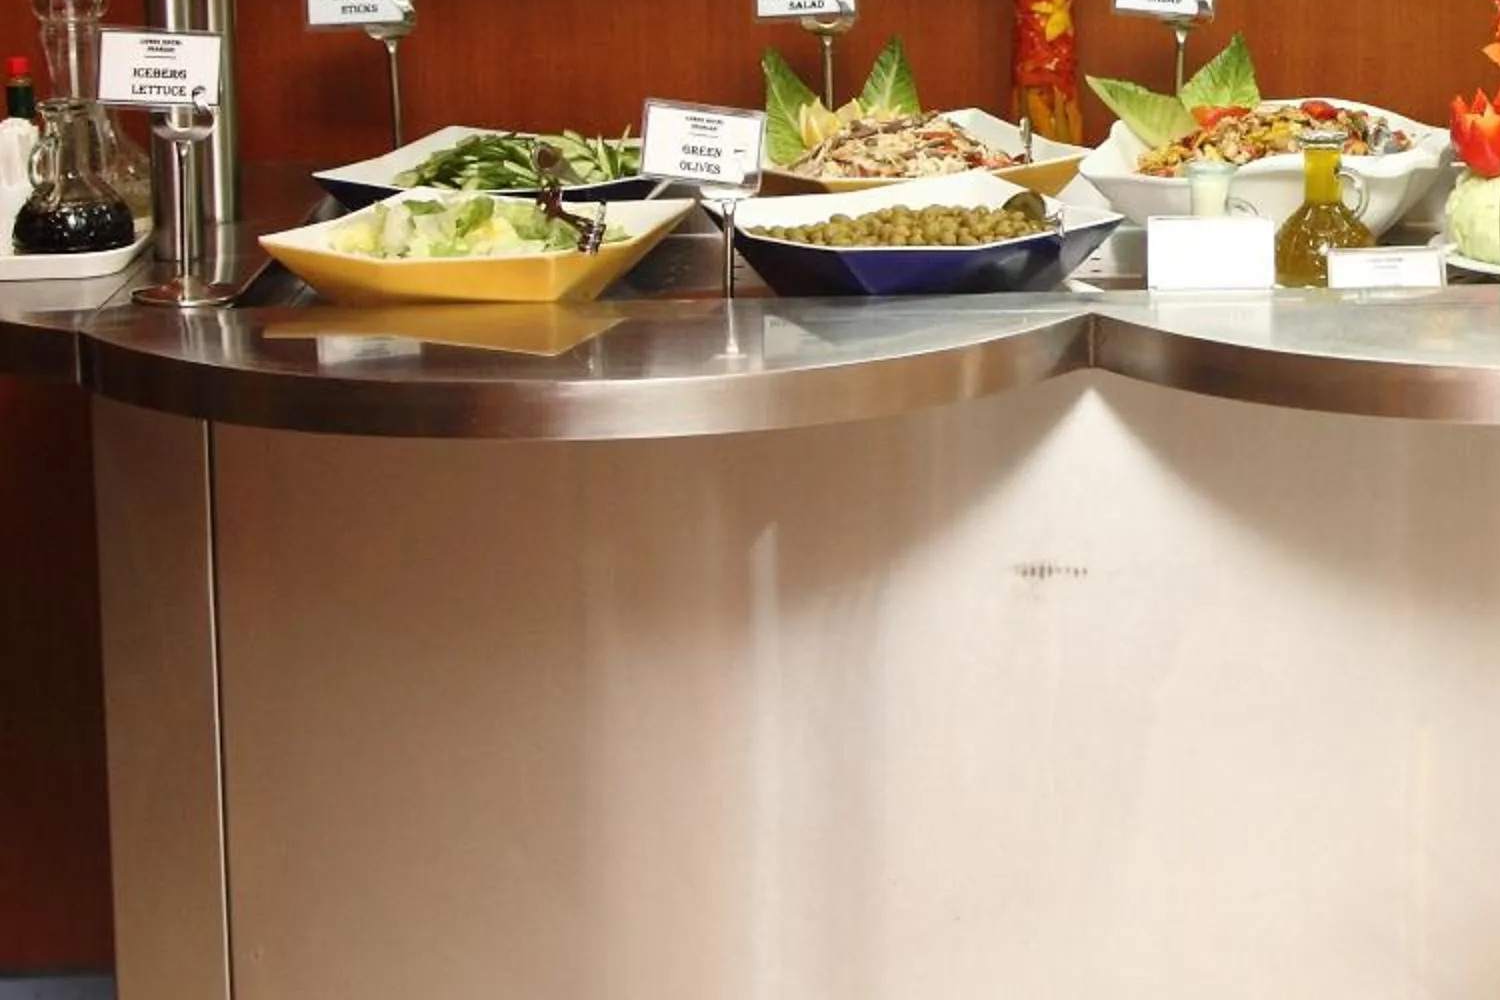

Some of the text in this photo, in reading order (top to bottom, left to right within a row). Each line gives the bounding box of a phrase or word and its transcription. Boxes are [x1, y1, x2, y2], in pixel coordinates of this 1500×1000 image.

[788, 0, 825, 9] SALAD
[133, 67, 187, 79] ICEBERG
[131, 84, 187, 97] LETTUCE
[682, 144, 722, 158] GREEN
[679, 160, 721, 175] OLIVES
